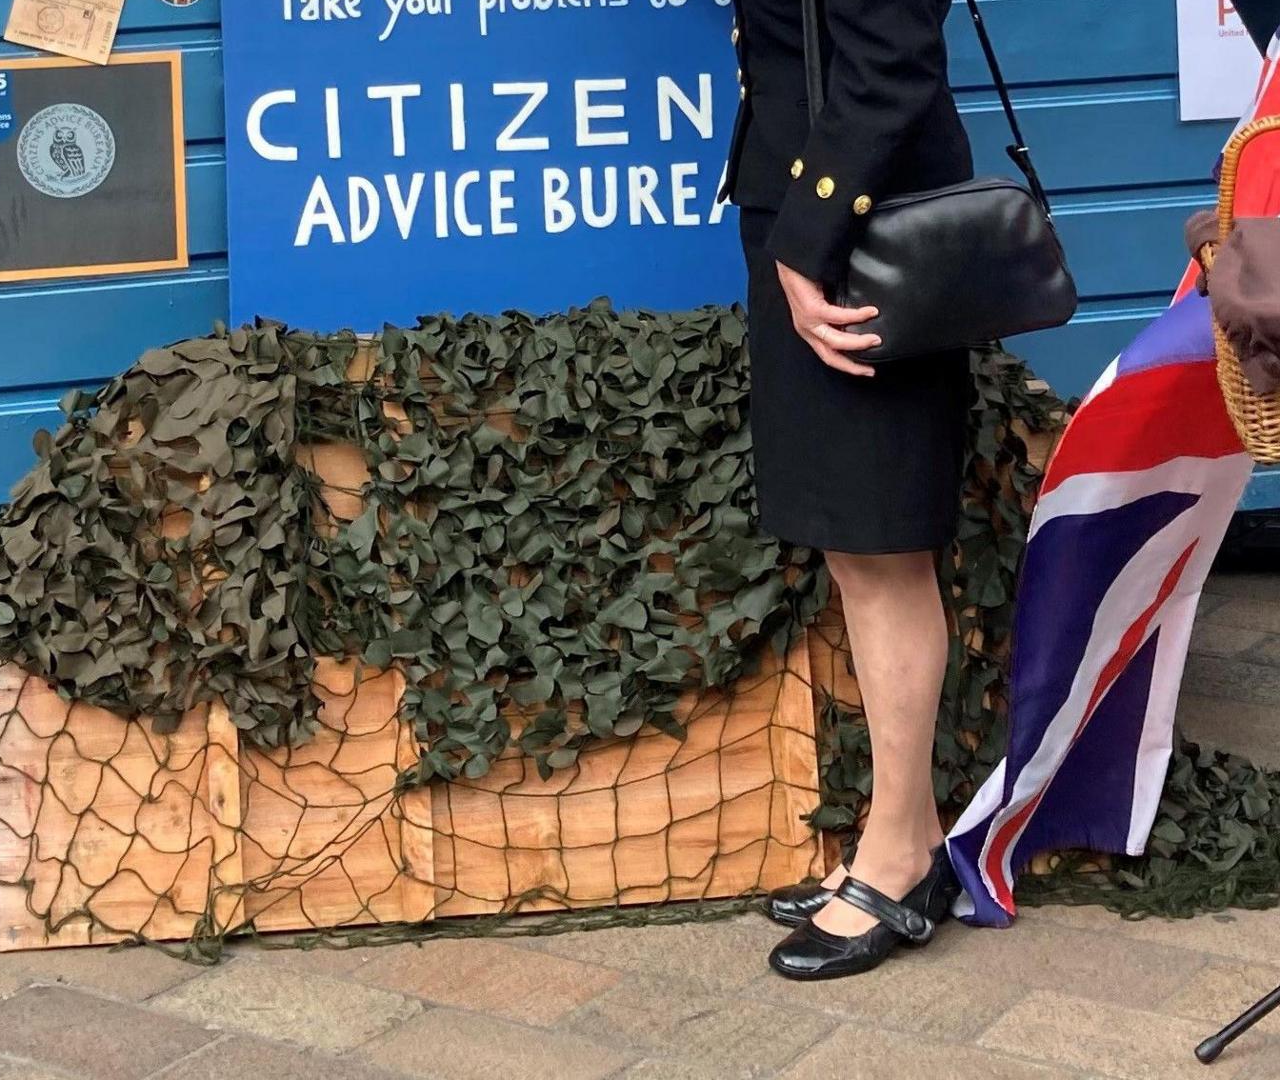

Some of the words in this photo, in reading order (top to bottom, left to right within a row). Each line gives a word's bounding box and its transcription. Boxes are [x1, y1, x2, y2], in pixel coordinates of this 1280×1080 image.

[45, 114, 82, 129] ADVICE
[246, 73, 714, 162] CITIZEN
[294, 169, 519, 247] ADVICE
[543, 160, 733, 234] BUREA
